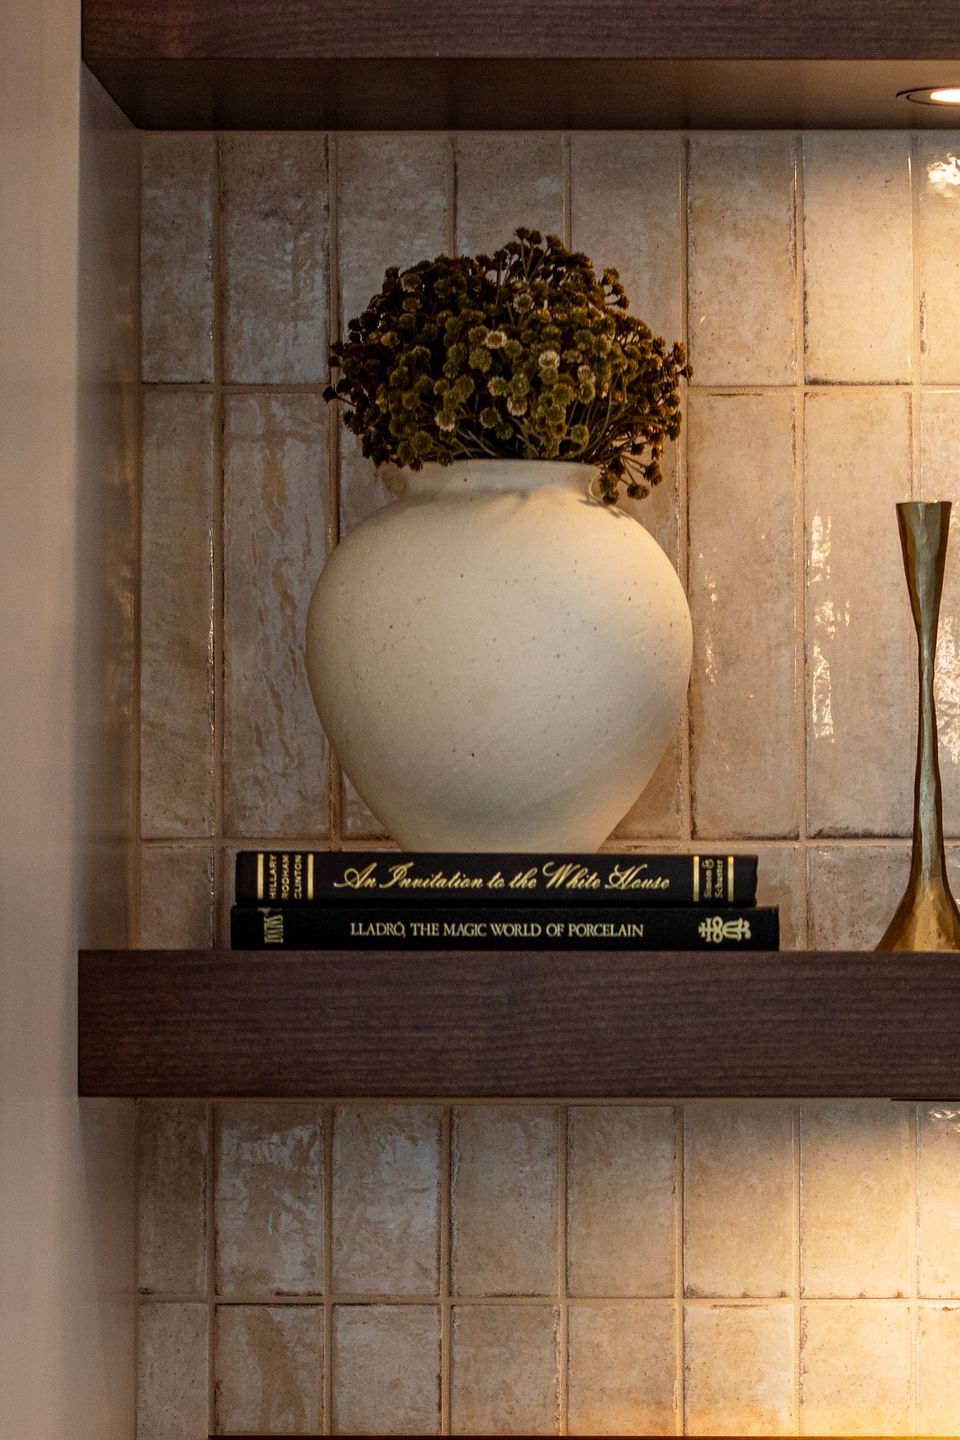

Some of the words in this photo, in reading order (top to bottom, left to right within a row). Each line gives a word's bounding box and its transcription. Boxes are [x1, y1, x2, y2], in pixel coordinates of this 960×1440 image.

[282, 854, 290, 900] RODHAM
[294, 854, 302, 900] CLINTON
[333, 862, 377, 889] An
[379, 861, 484, 889] Invitation
[487, 871, 506, 889] to
[508, 867, 538, 889] the
[542, 861, 600, 890] White
[604, 864, 670, 890] House
[410, 922, 440, 937] THE
[443, 922, 487, 937] MAGIC
[490, 922, 542, 938] WORLD
[546, 922, 565, 938] OF
[568, 923, 644, 938] PORCELAIN
